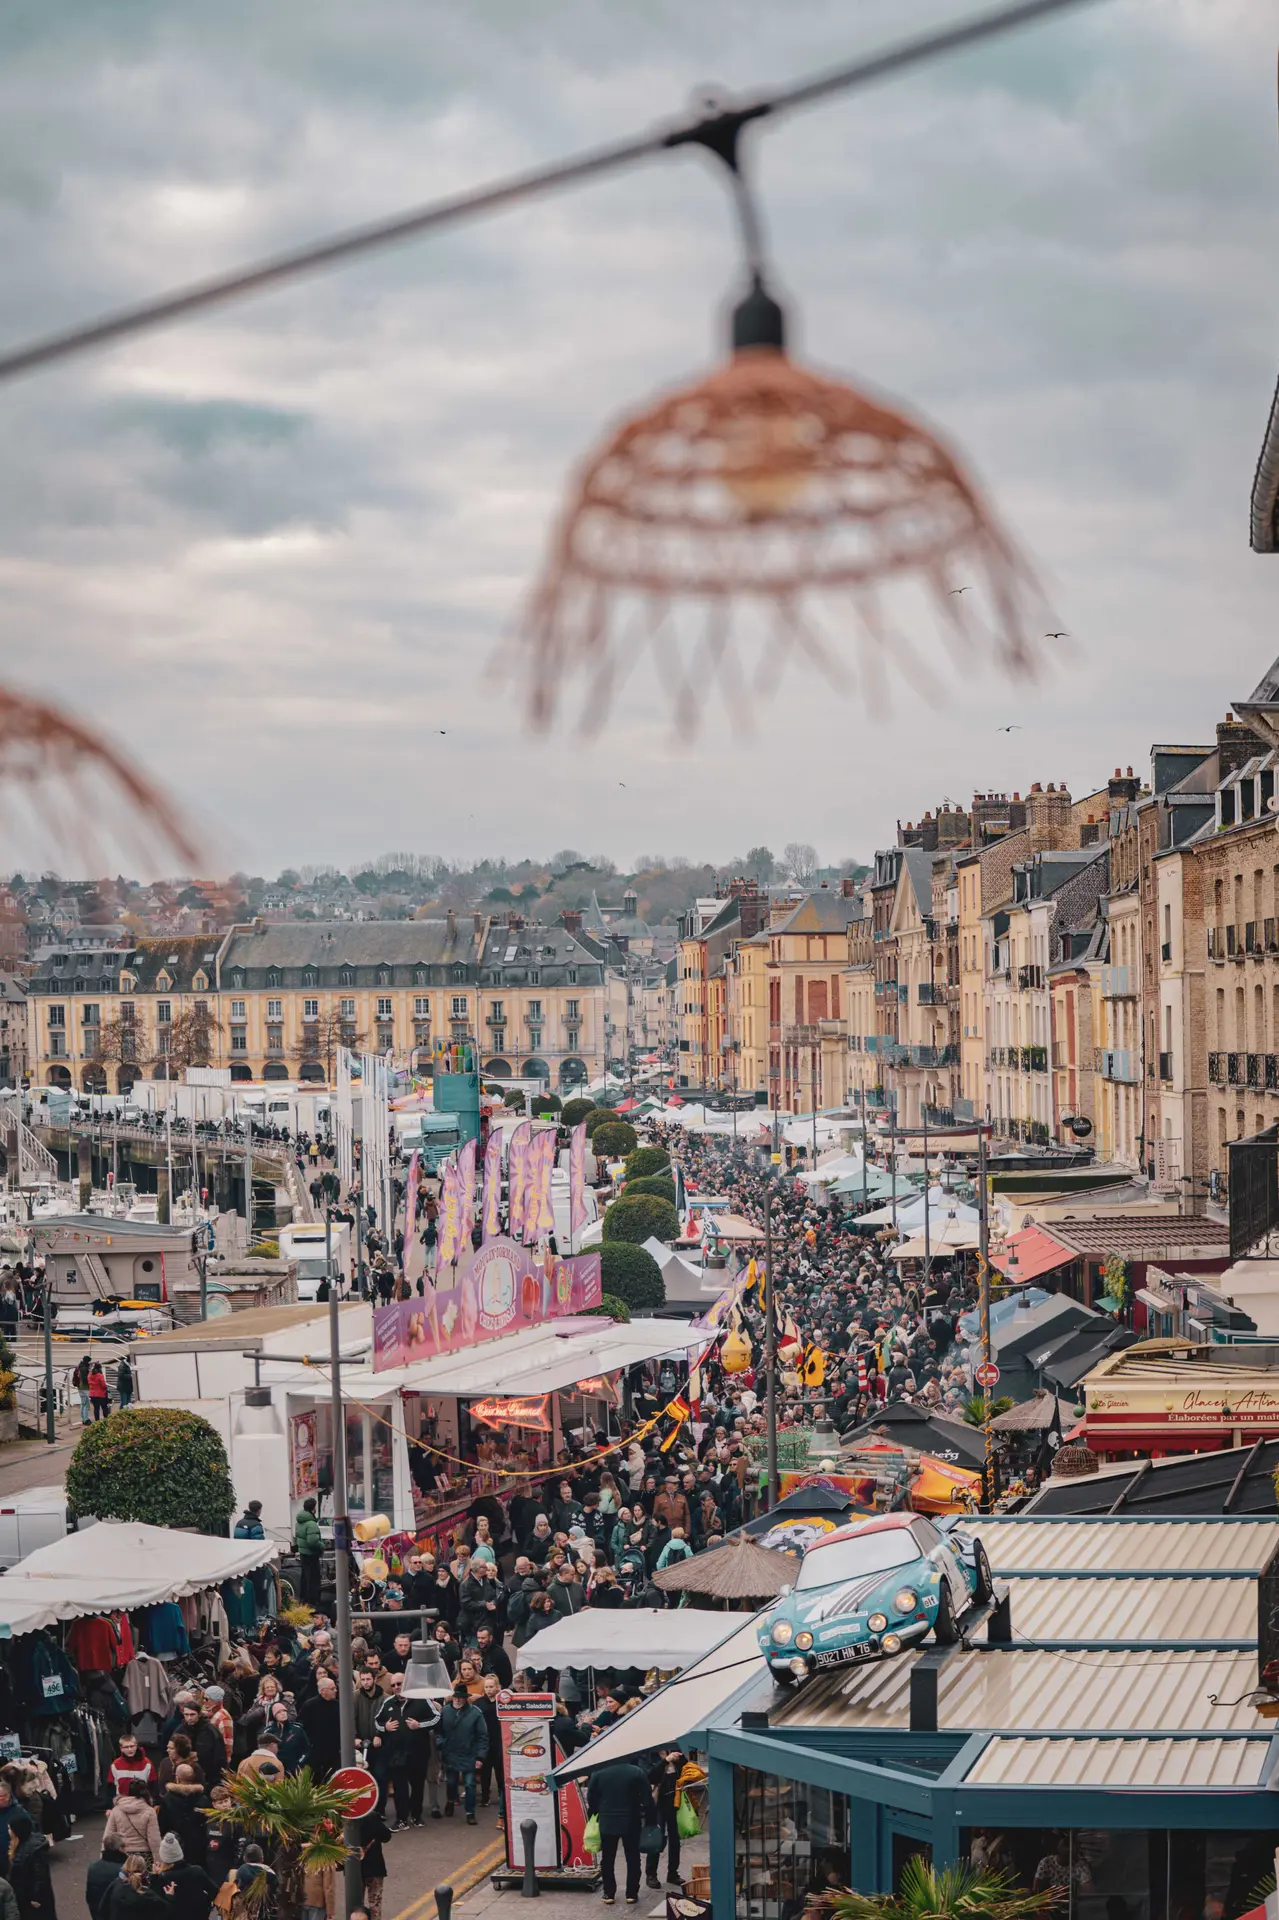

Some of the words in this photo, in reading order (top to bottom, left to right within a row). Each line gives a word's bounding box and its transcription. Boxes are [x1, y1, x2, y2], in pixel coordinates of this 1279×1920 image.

[1168, 1412, 1218, 1421] Élaborées
[1220, 1415, 1238, 1423] par
[924, 1596, 936, 1608] elf
[817, 1652, 840, 1665] 9027
[842, 1649, 856, 1659] HN
[859, 1643, 870, 1654] 76
[526, 1702, 552, 1710] Saladerie
